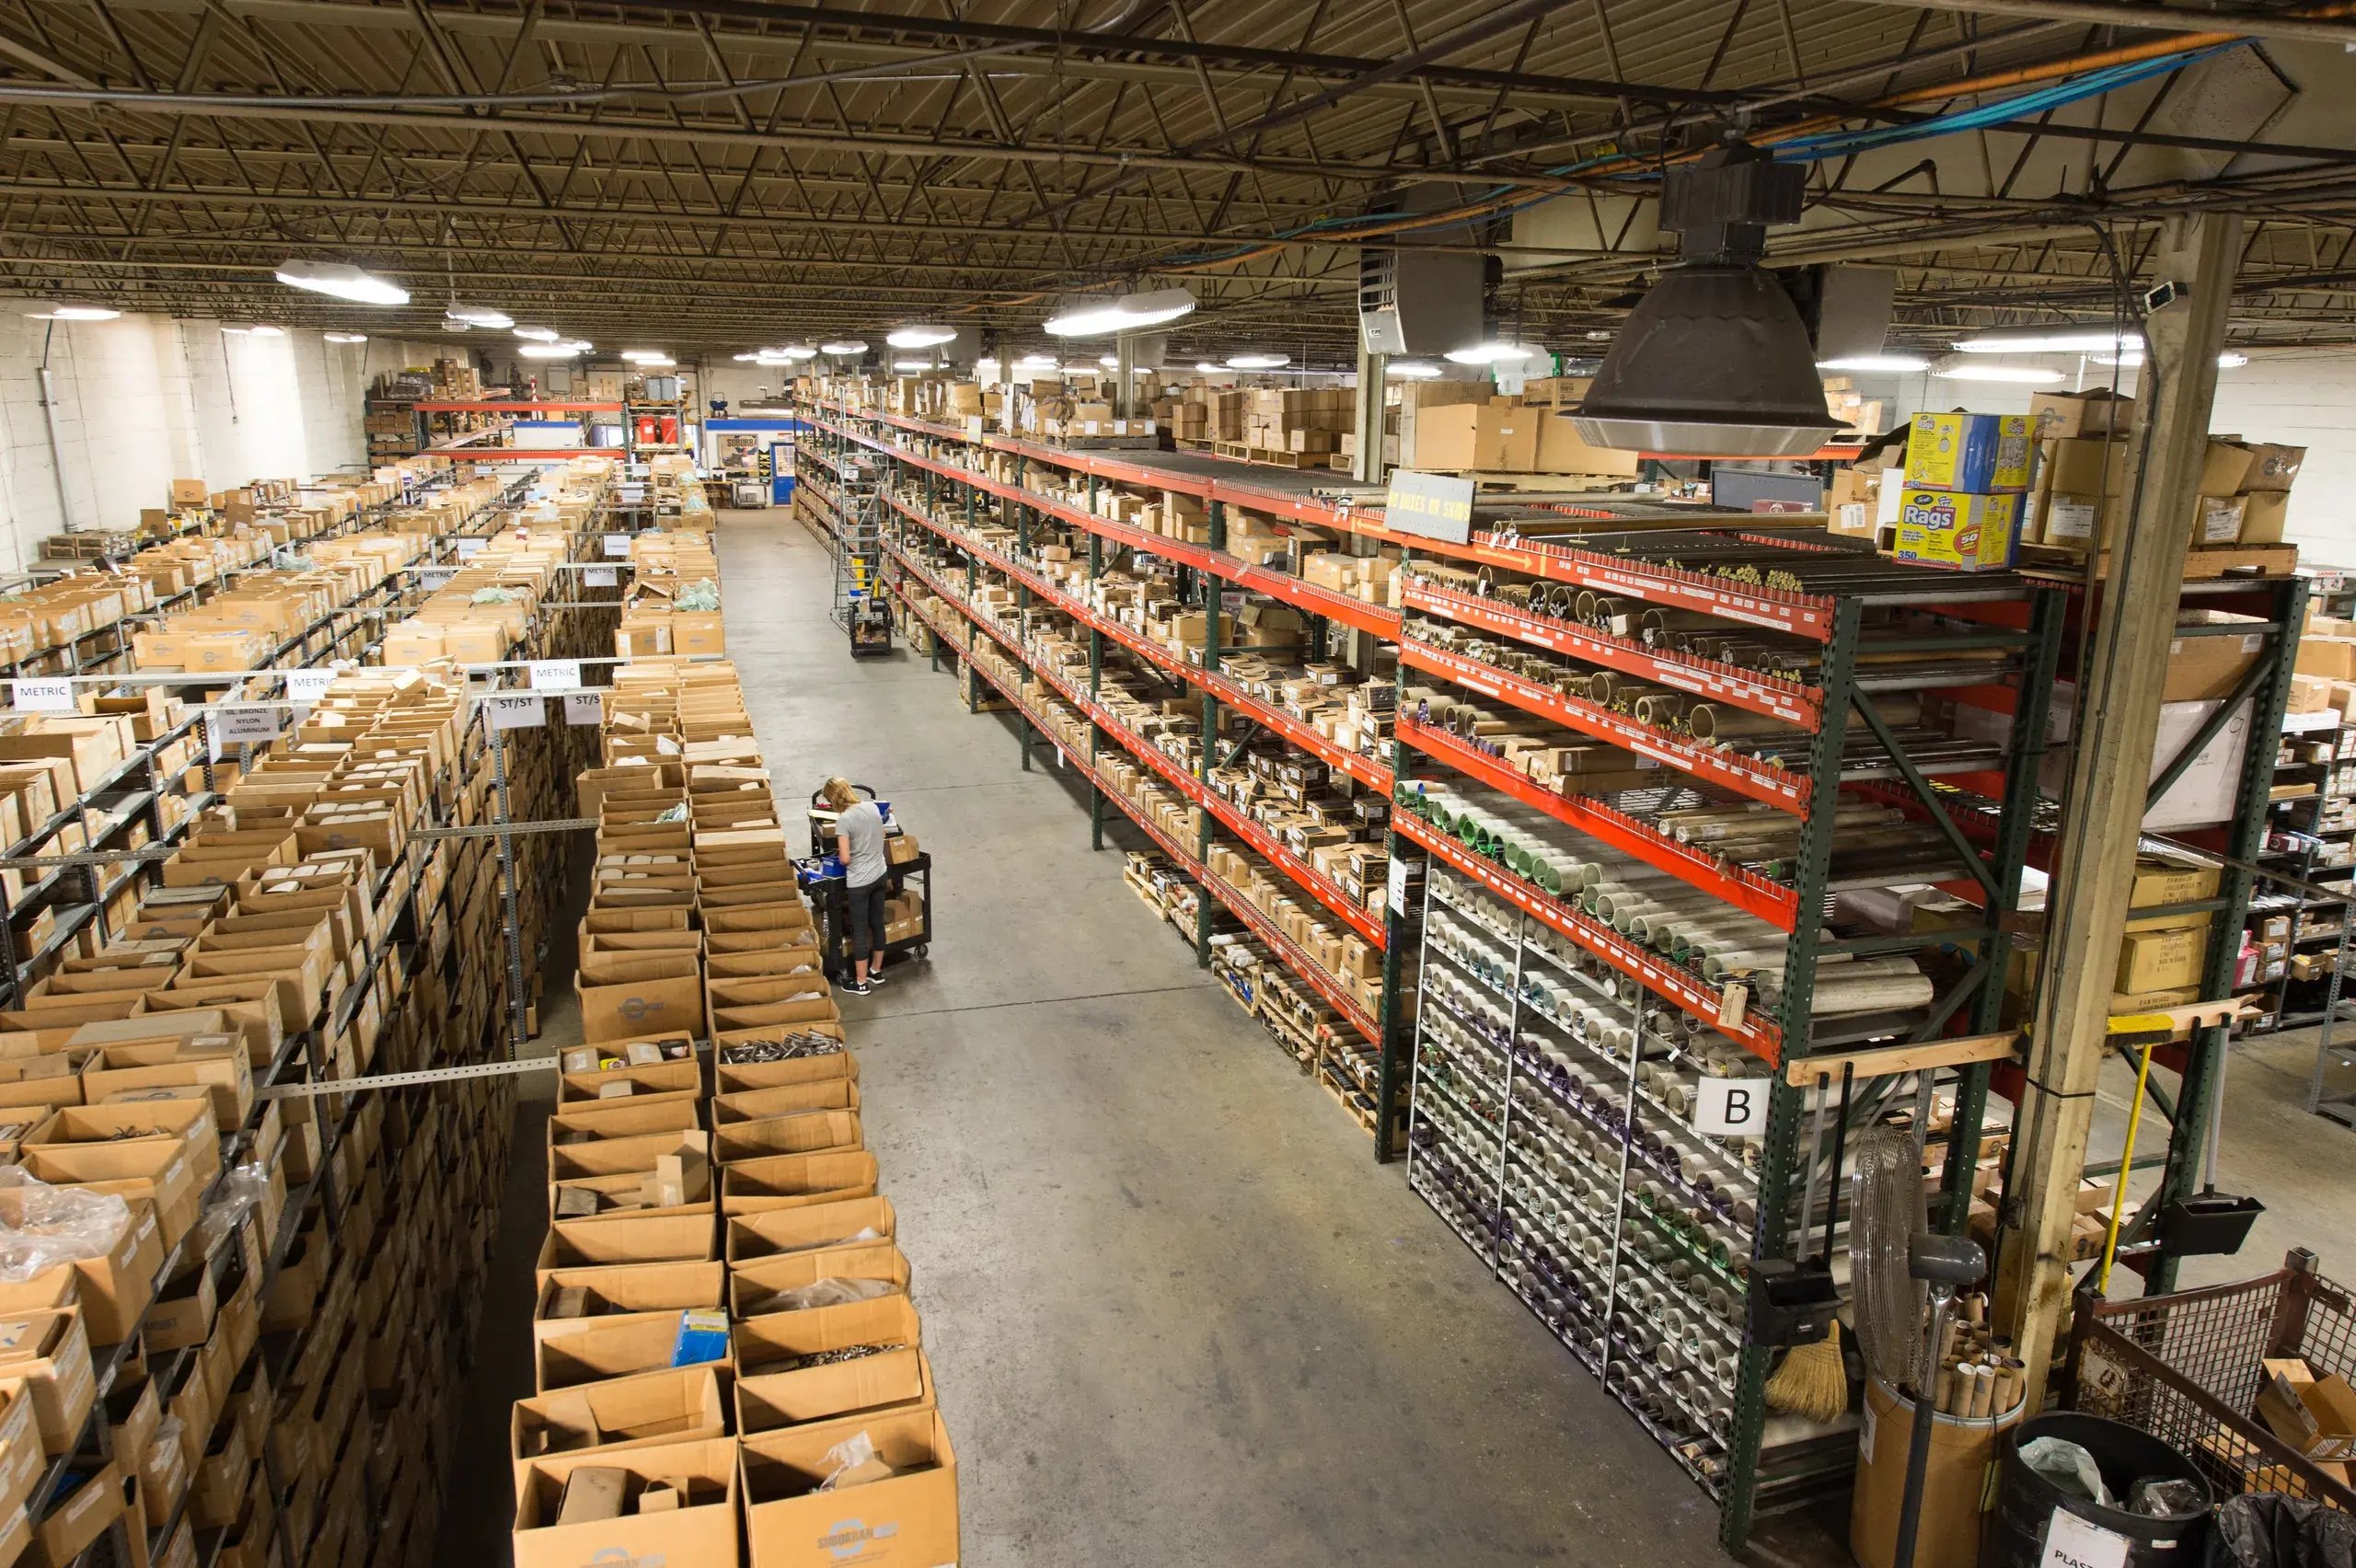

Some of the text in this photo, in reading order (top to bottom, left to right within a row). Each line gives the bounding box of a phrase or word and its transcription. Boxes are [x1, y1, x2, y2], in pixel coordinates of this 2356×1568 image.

[1428, 497, 1441, 515] OR
[1905, 506, 1951, 530] Rags
[1961, 534, 1979, 544] 50
[1898, 550, 1917, 560] 350
[537, 668, 575, 677] METRIC
[20, 686, 66, 697] METRIC
[500, 698, 533, 709] ST/ST
[576, 695, 600, 706] ST/S
[1725, 1089, 1750, 1124] B
[817, 1528, 874, 1550] SUBURBAN
[2054, 1550, 2095, 1568] PLAS
